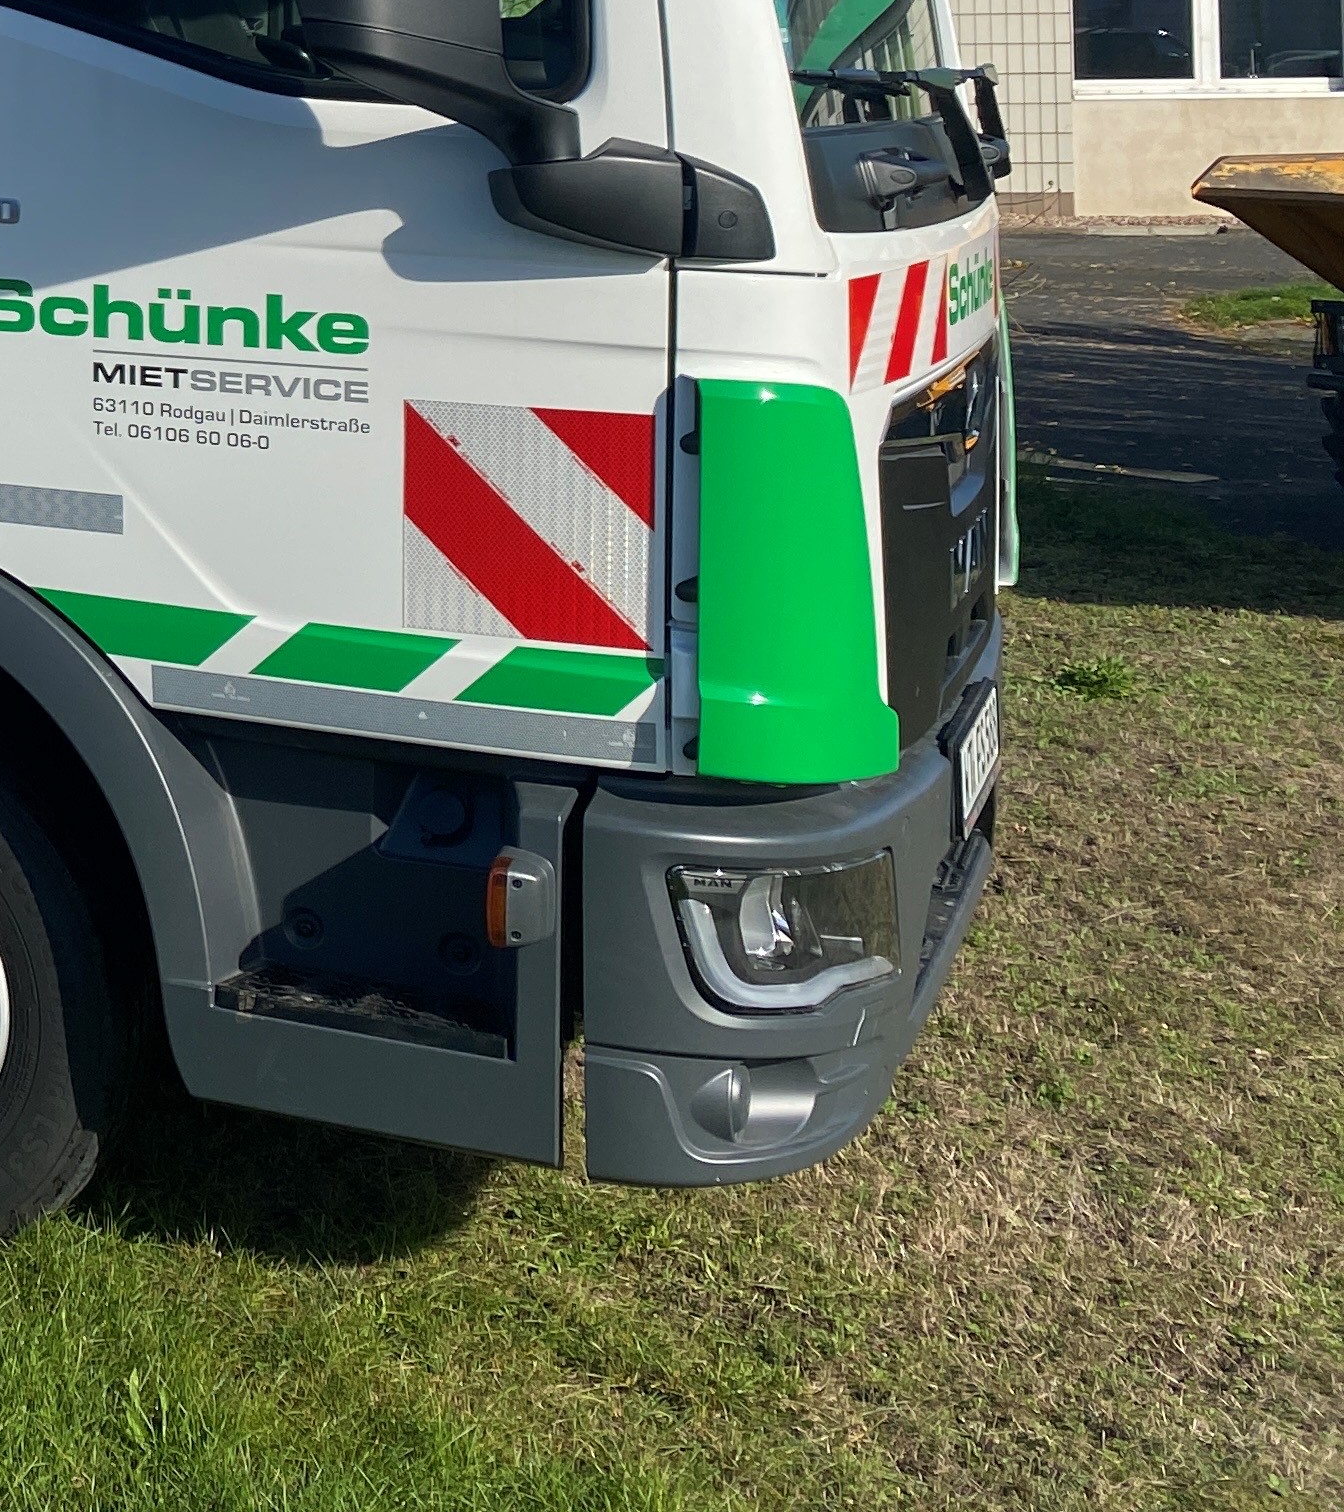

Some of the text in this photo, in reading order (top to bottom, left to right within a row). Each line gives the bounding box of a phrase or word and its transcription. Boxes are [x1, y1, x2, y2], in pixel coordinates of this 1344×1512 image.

[92, 362, 370, 404] MIETSERVICE
[92, 396, 155, 417] 63110
[159, 401, 226, 424] Rodgau
[239, 409, 371, 434] Daimlerstraße
[92, 420, 270, 450] Tel. 06106 60 06-0
[693, 878, 733, 889] MAN
